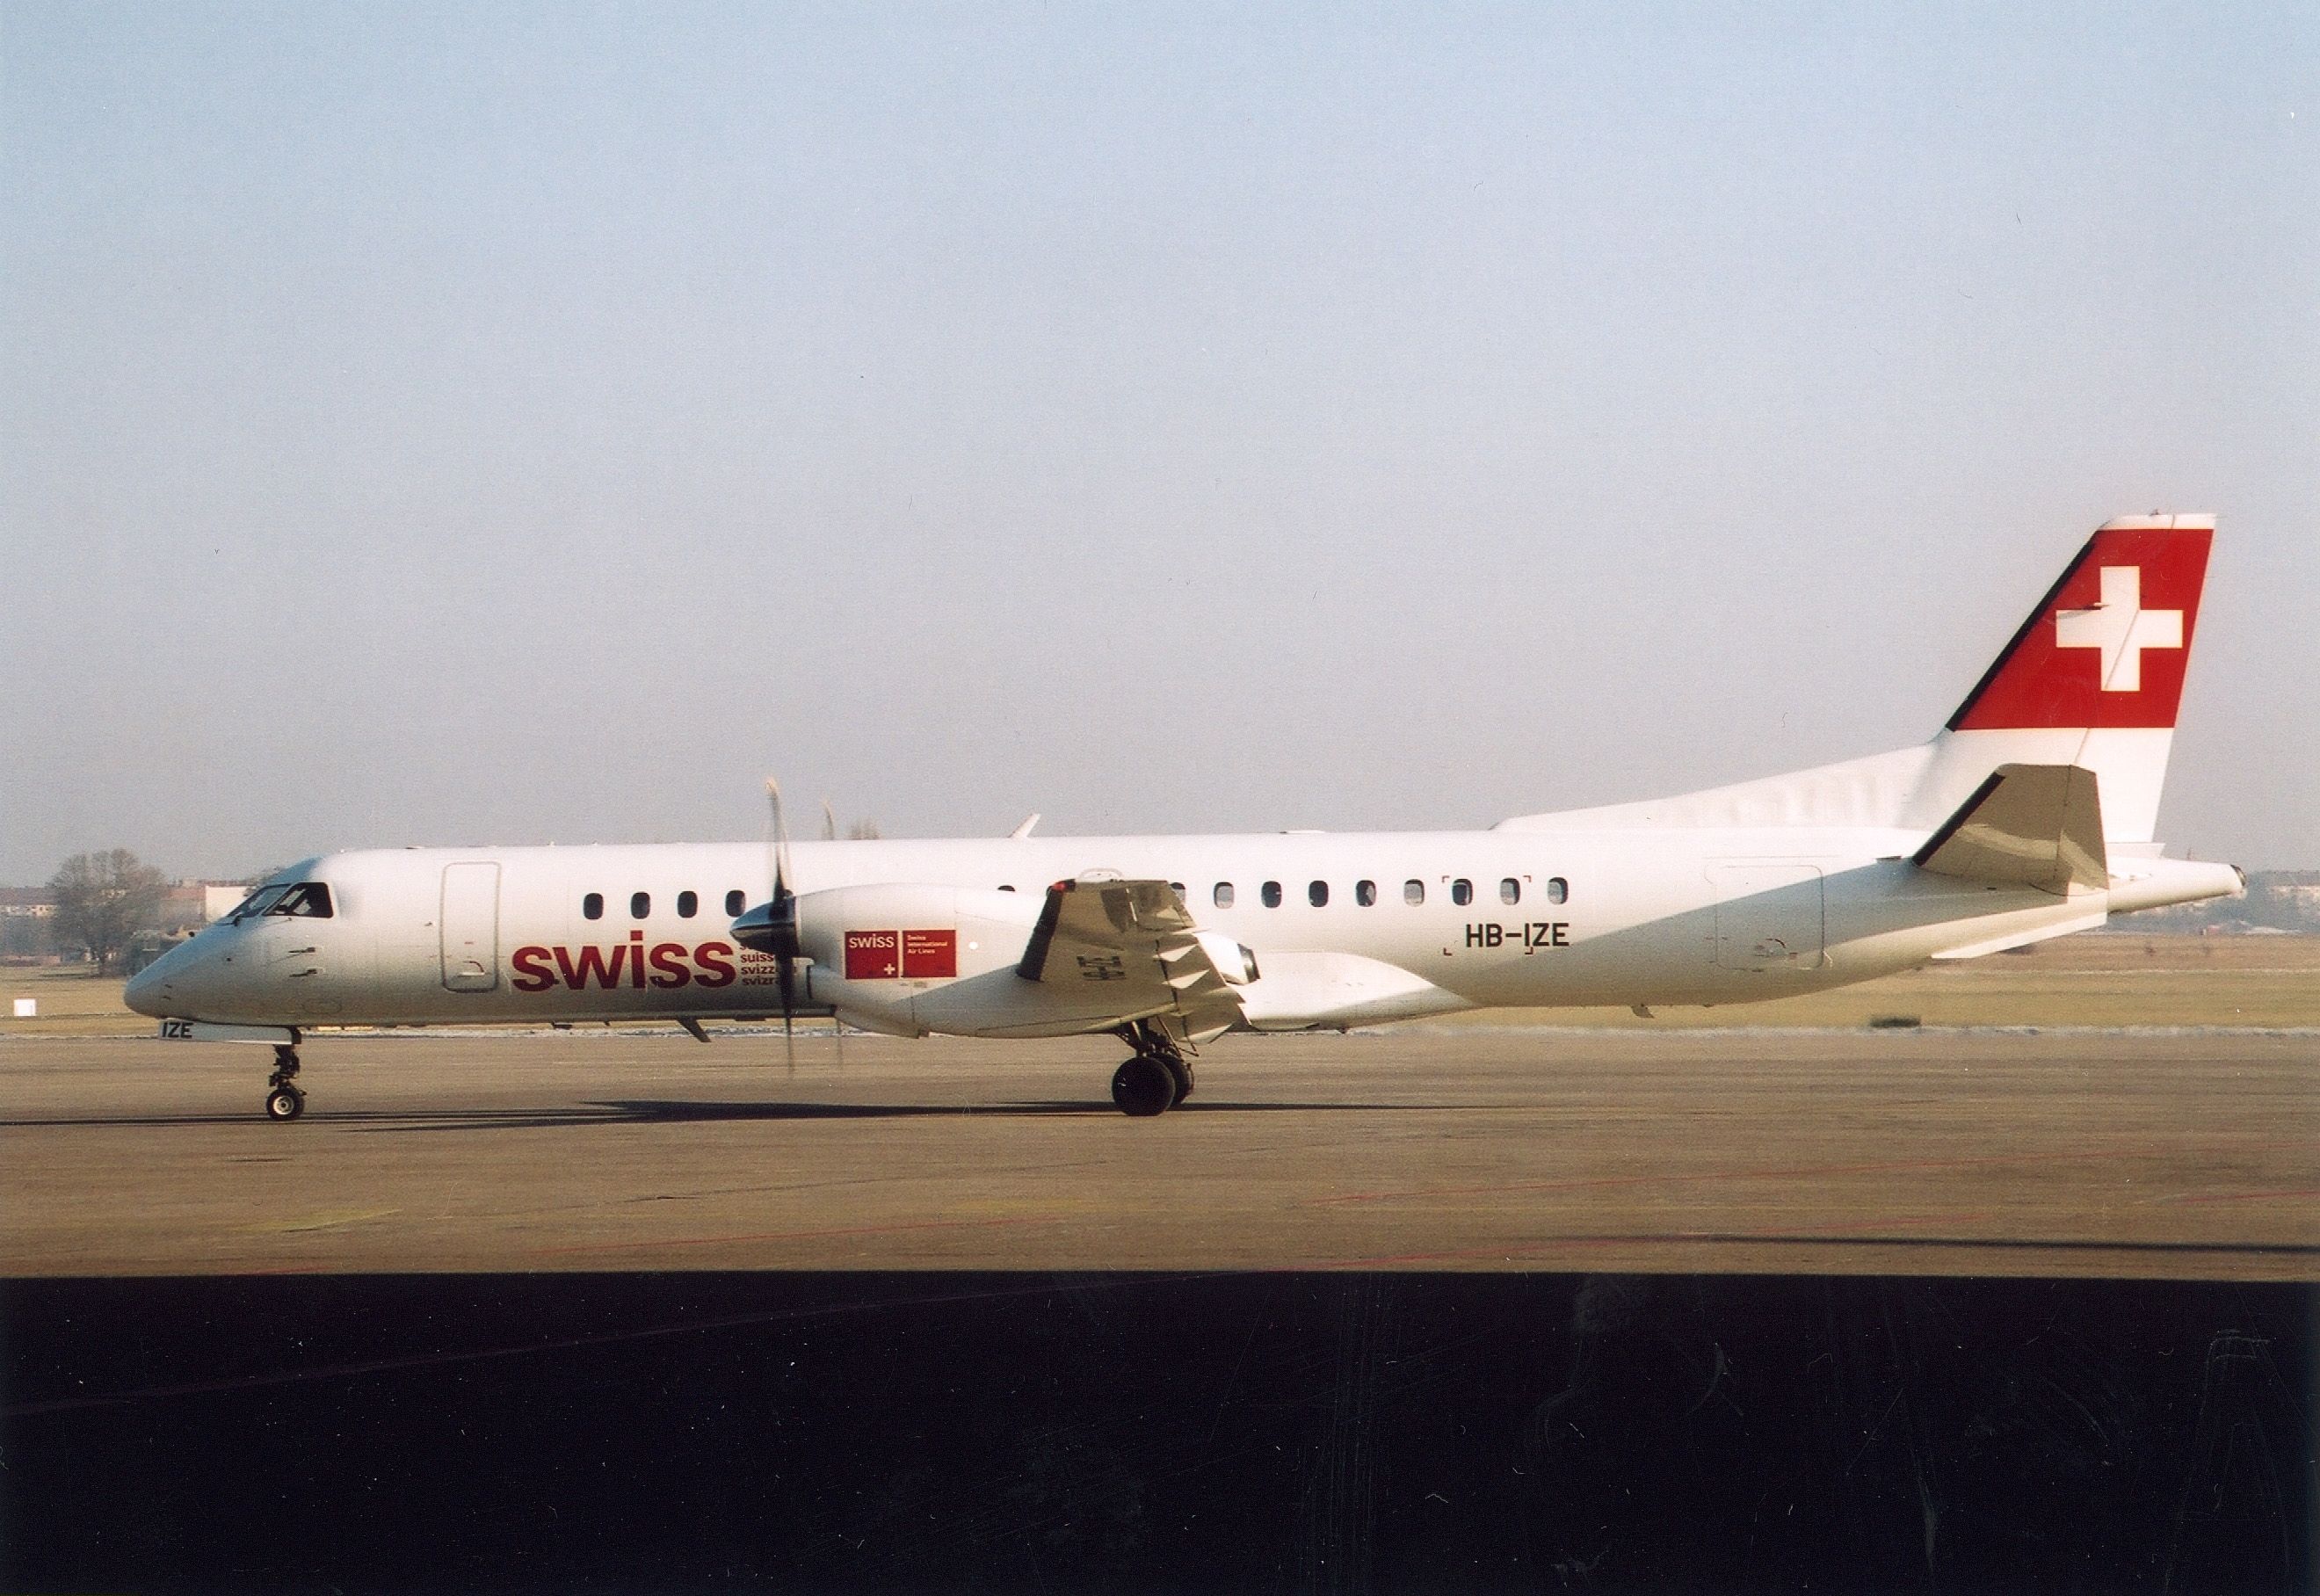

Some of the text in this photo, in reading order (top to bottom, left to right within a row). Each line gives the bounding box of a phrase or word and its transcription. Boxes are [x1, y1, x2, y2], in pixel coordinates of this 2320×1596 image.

[849, 933, 895, 948] swiss
[1466, 923, 1570, 947] HB-IZE
[511, 929, 736, 991] swiss
[740, 952, 774, 963] suiss
[741, 963, 779, 975] svizz
[162, 1022, 194, 1039] IZE
